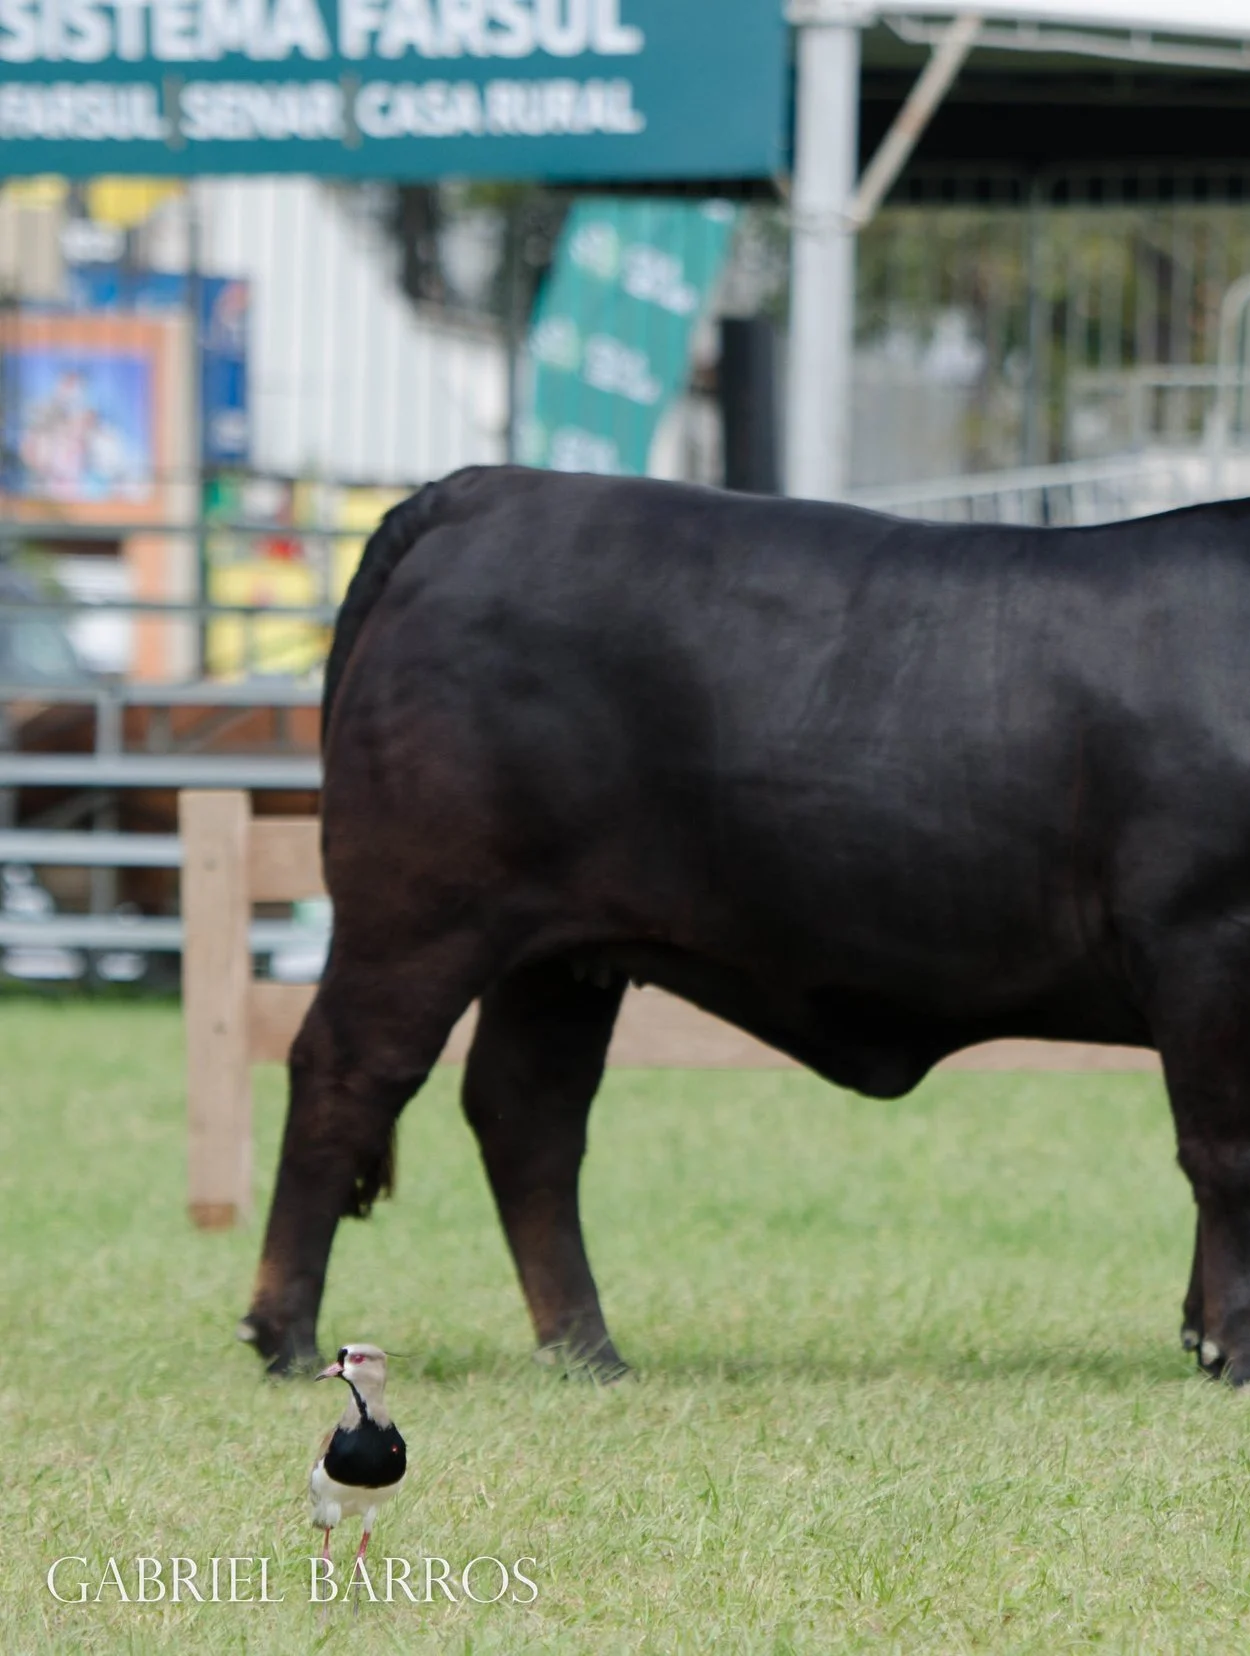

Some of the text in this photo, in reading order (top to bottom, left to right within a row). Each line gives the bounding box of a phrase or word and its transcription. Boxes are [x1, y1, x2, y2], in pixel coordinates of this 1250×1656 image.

[0, 0, 646, 62] SISTEMA FARSUL
[178, 79, 344, 140] SENAR
[355, 79, 483, 139] CASA
[484, 77, 647, 136] RURAL
